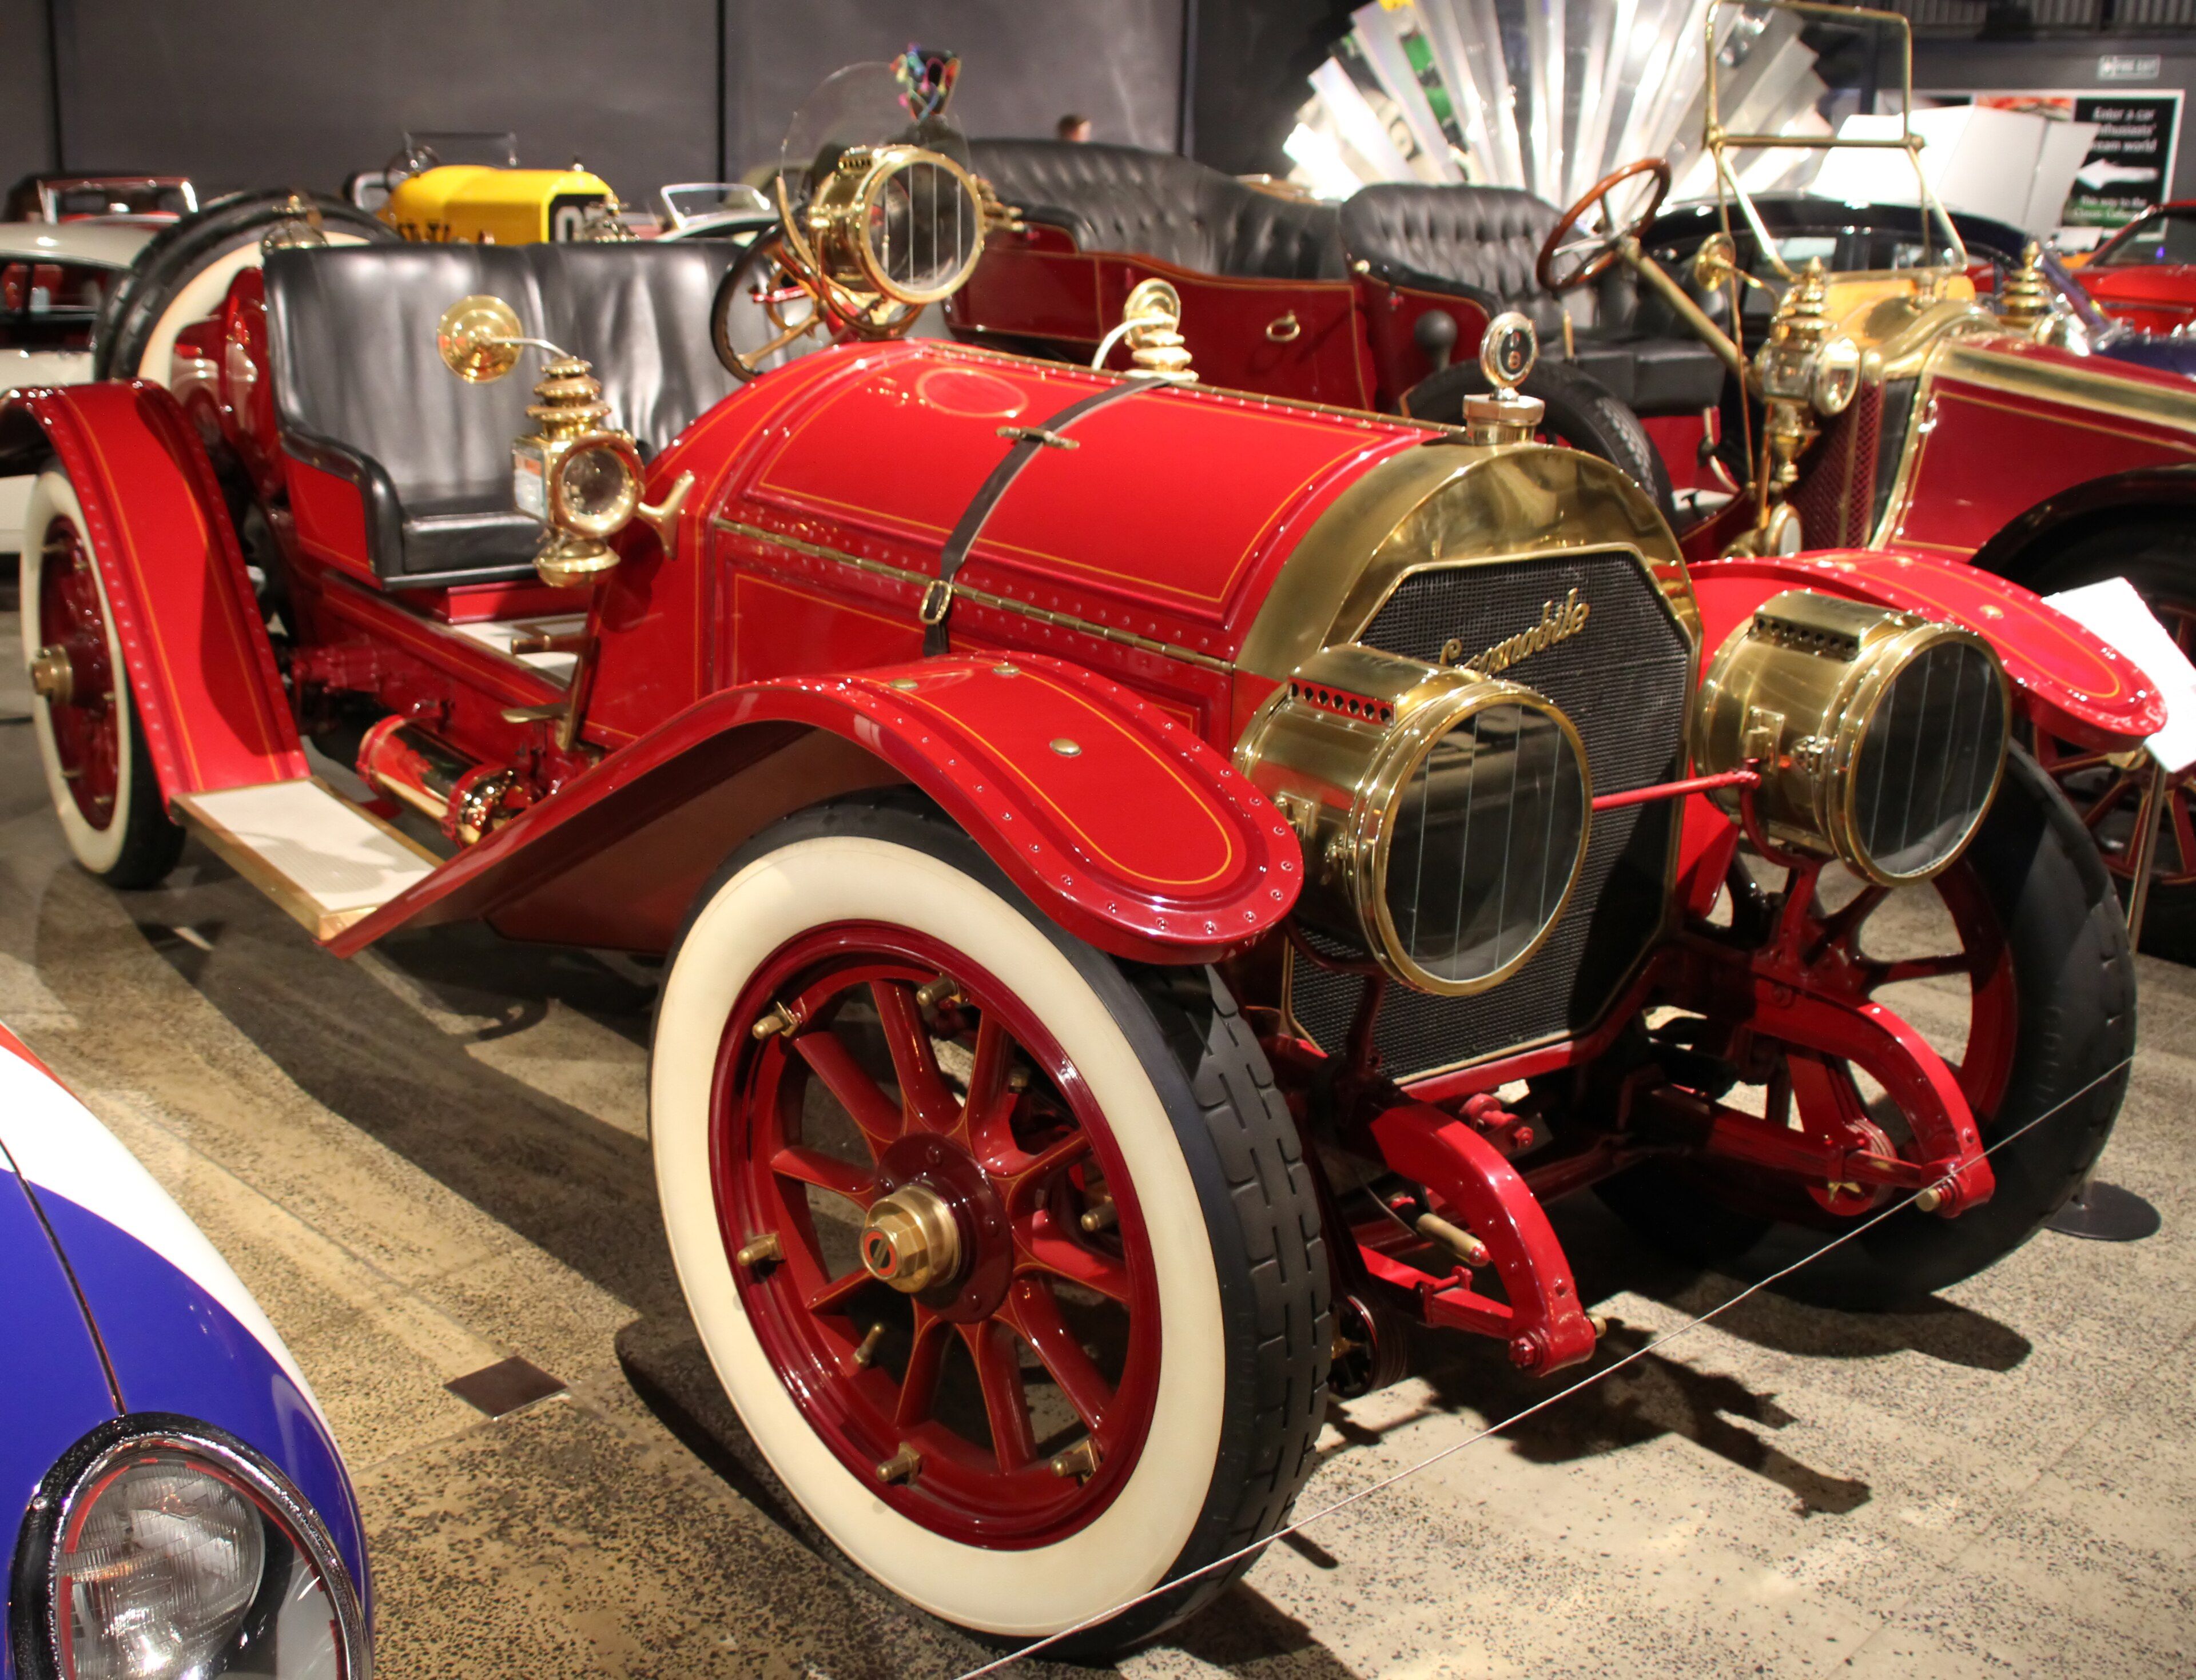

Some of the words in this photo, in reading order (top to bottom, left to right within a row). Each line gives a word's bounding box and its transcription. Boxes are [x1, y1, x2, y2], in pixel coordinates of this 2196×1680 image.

[2093, 106, 2123, 121] Enter
[2126, 109, 2134, 121] a
[2135, 109, 2155, 121] car
[2092, 141, 2121, 152] ream
[2123, 139, 2157, 153] world
[1439, 587, 1590, 676] Lcomobile
